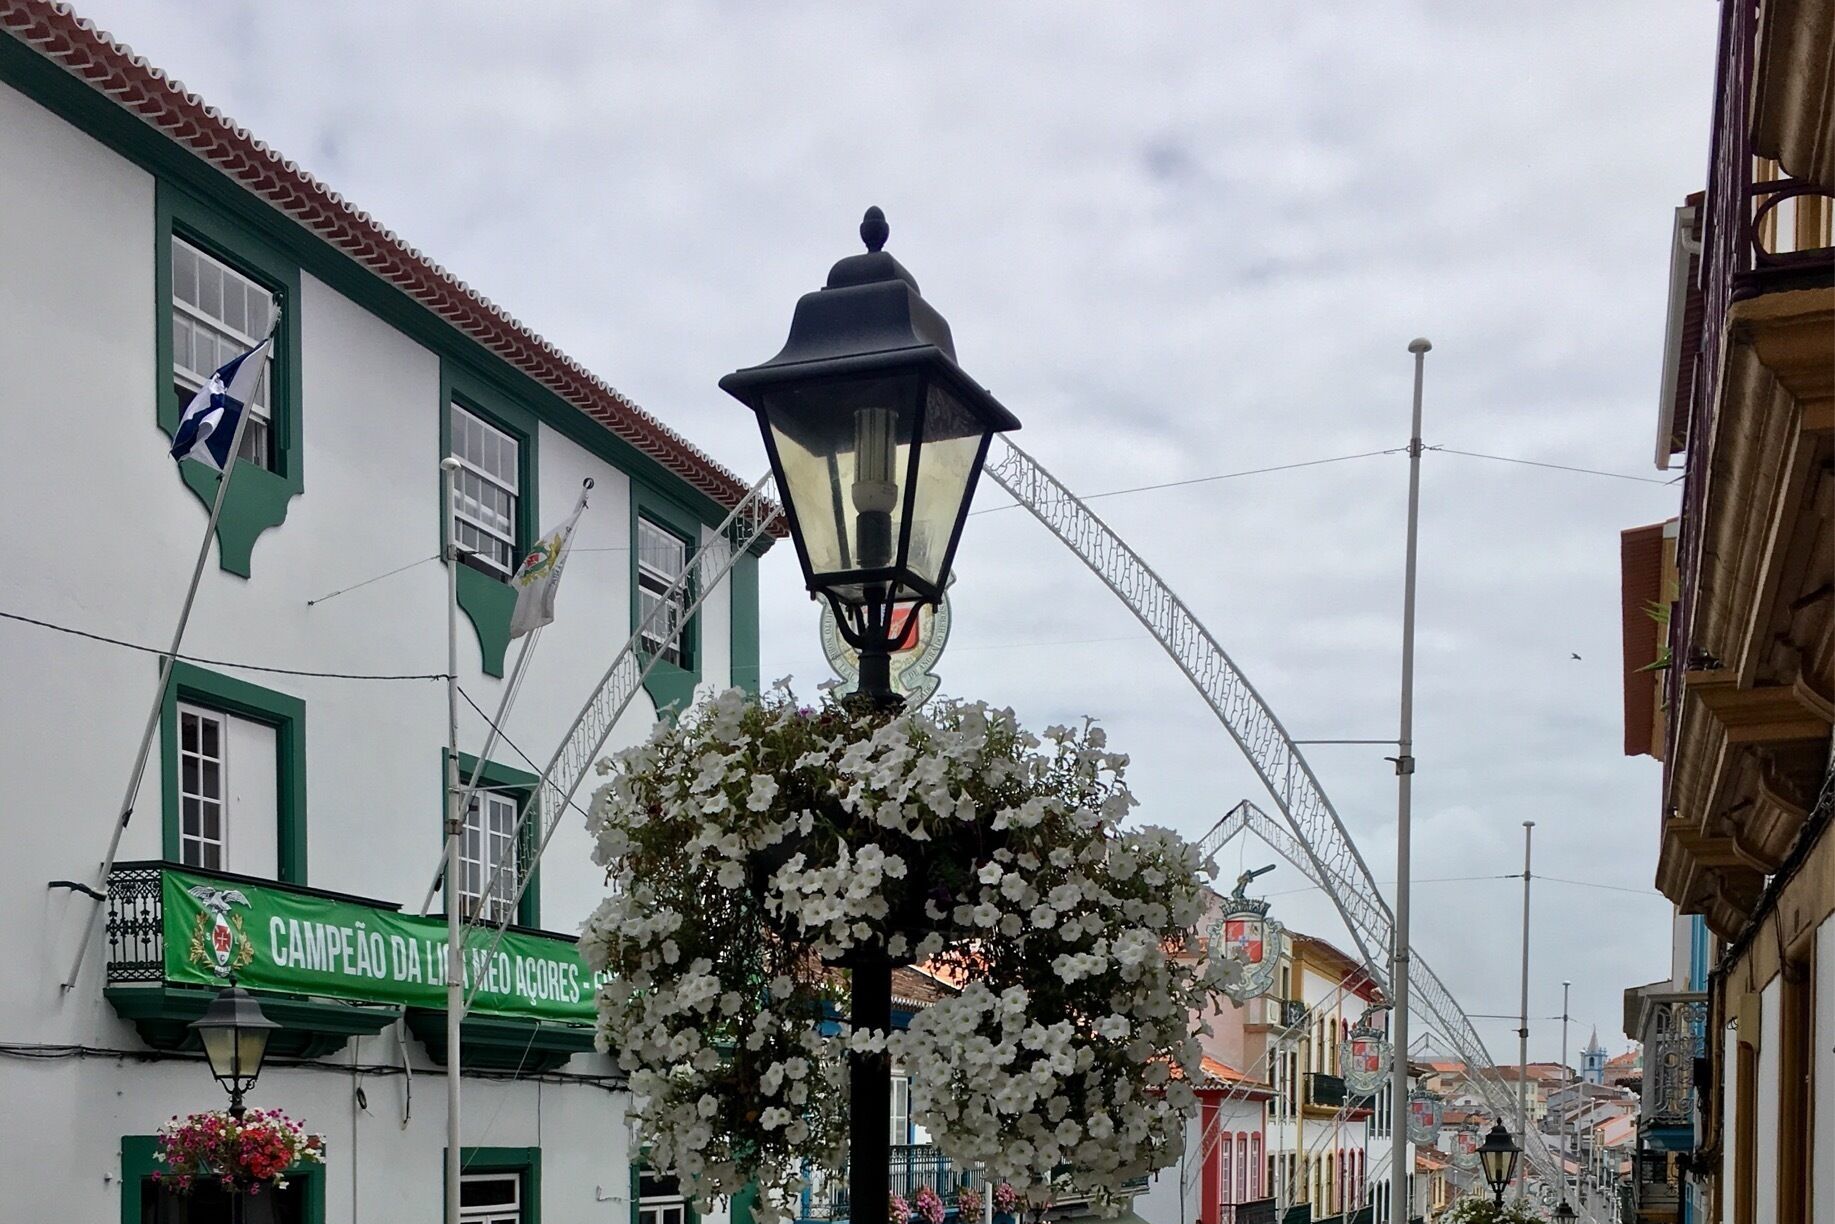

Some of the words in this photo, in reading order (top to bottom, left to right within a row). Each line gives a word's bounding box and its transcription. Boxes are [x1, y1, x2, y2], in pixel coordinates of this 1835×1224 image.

[269, 916, 387, 979] CAMPEÃO
[390, 935, 422, 984] DA
[472, 947, 511, 995] MEO
[516, 955, 580, 1006] AÇORES
